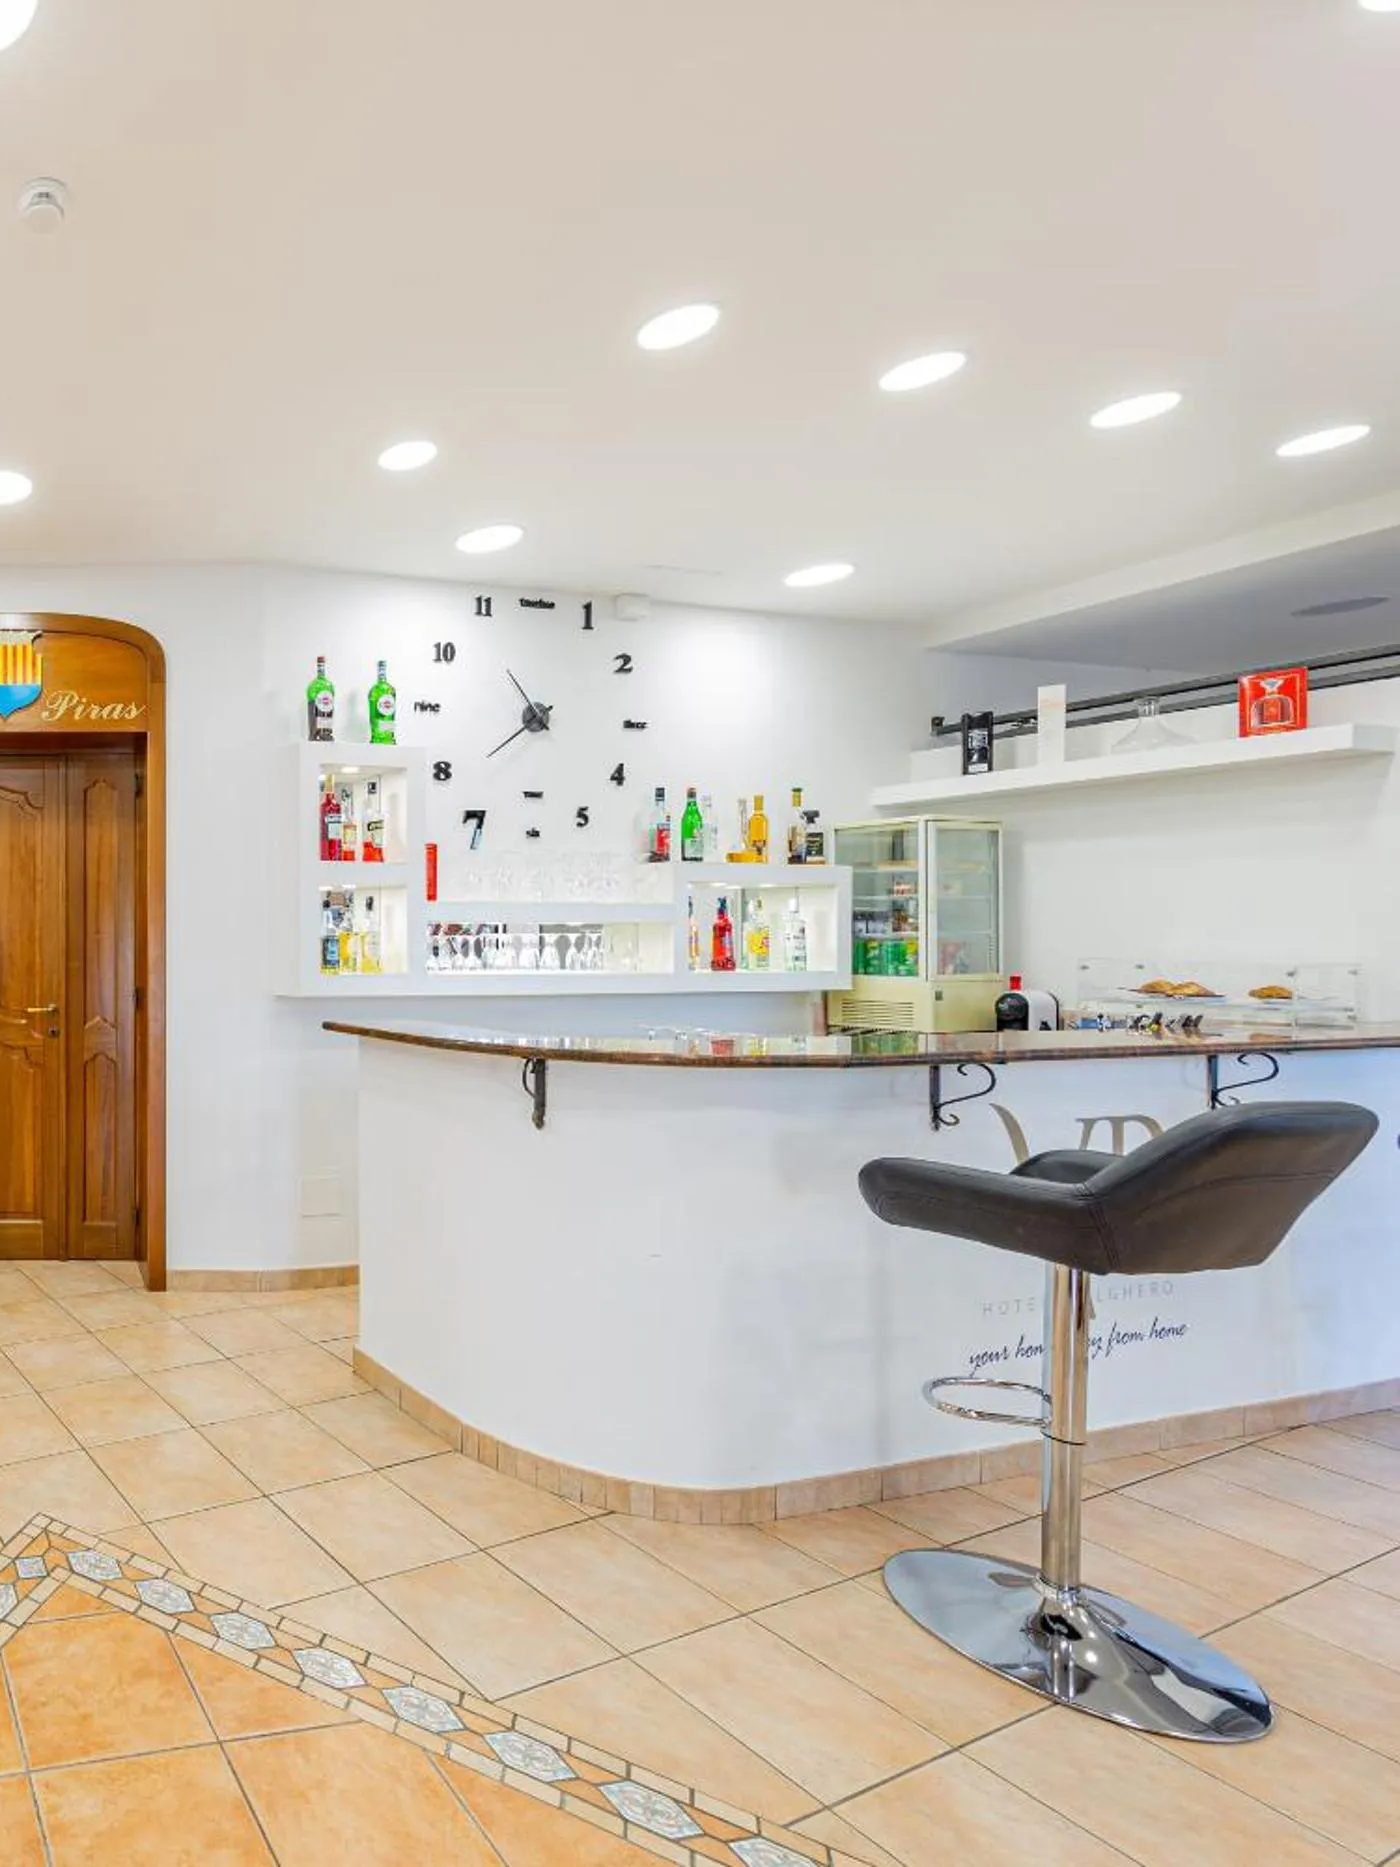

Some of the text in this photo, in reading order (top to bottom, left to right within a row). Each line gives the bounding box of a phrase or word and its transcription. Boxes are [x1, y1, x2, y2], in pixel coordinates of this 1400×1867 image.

[474, 595, 492, 617] 11
[581, 601, 594, 630] 1
[433, 641, 456, 664] 10
[613, 653, 634, 674] 2
[41, 690, 148, 721] Piras
[433, 761, 452, 782] 8
[610, 763, 625, 787] 4
[576, 807, 589, 828] 5
[462, 810, 487, 850] 7
[982, 1281, 1174, 1316] HOTE LGHERO
[969, 1345, 1008, 1377] your
[1105, 1321, 1143, 1357] from
[1149, 1316, 1187, 1339] home
